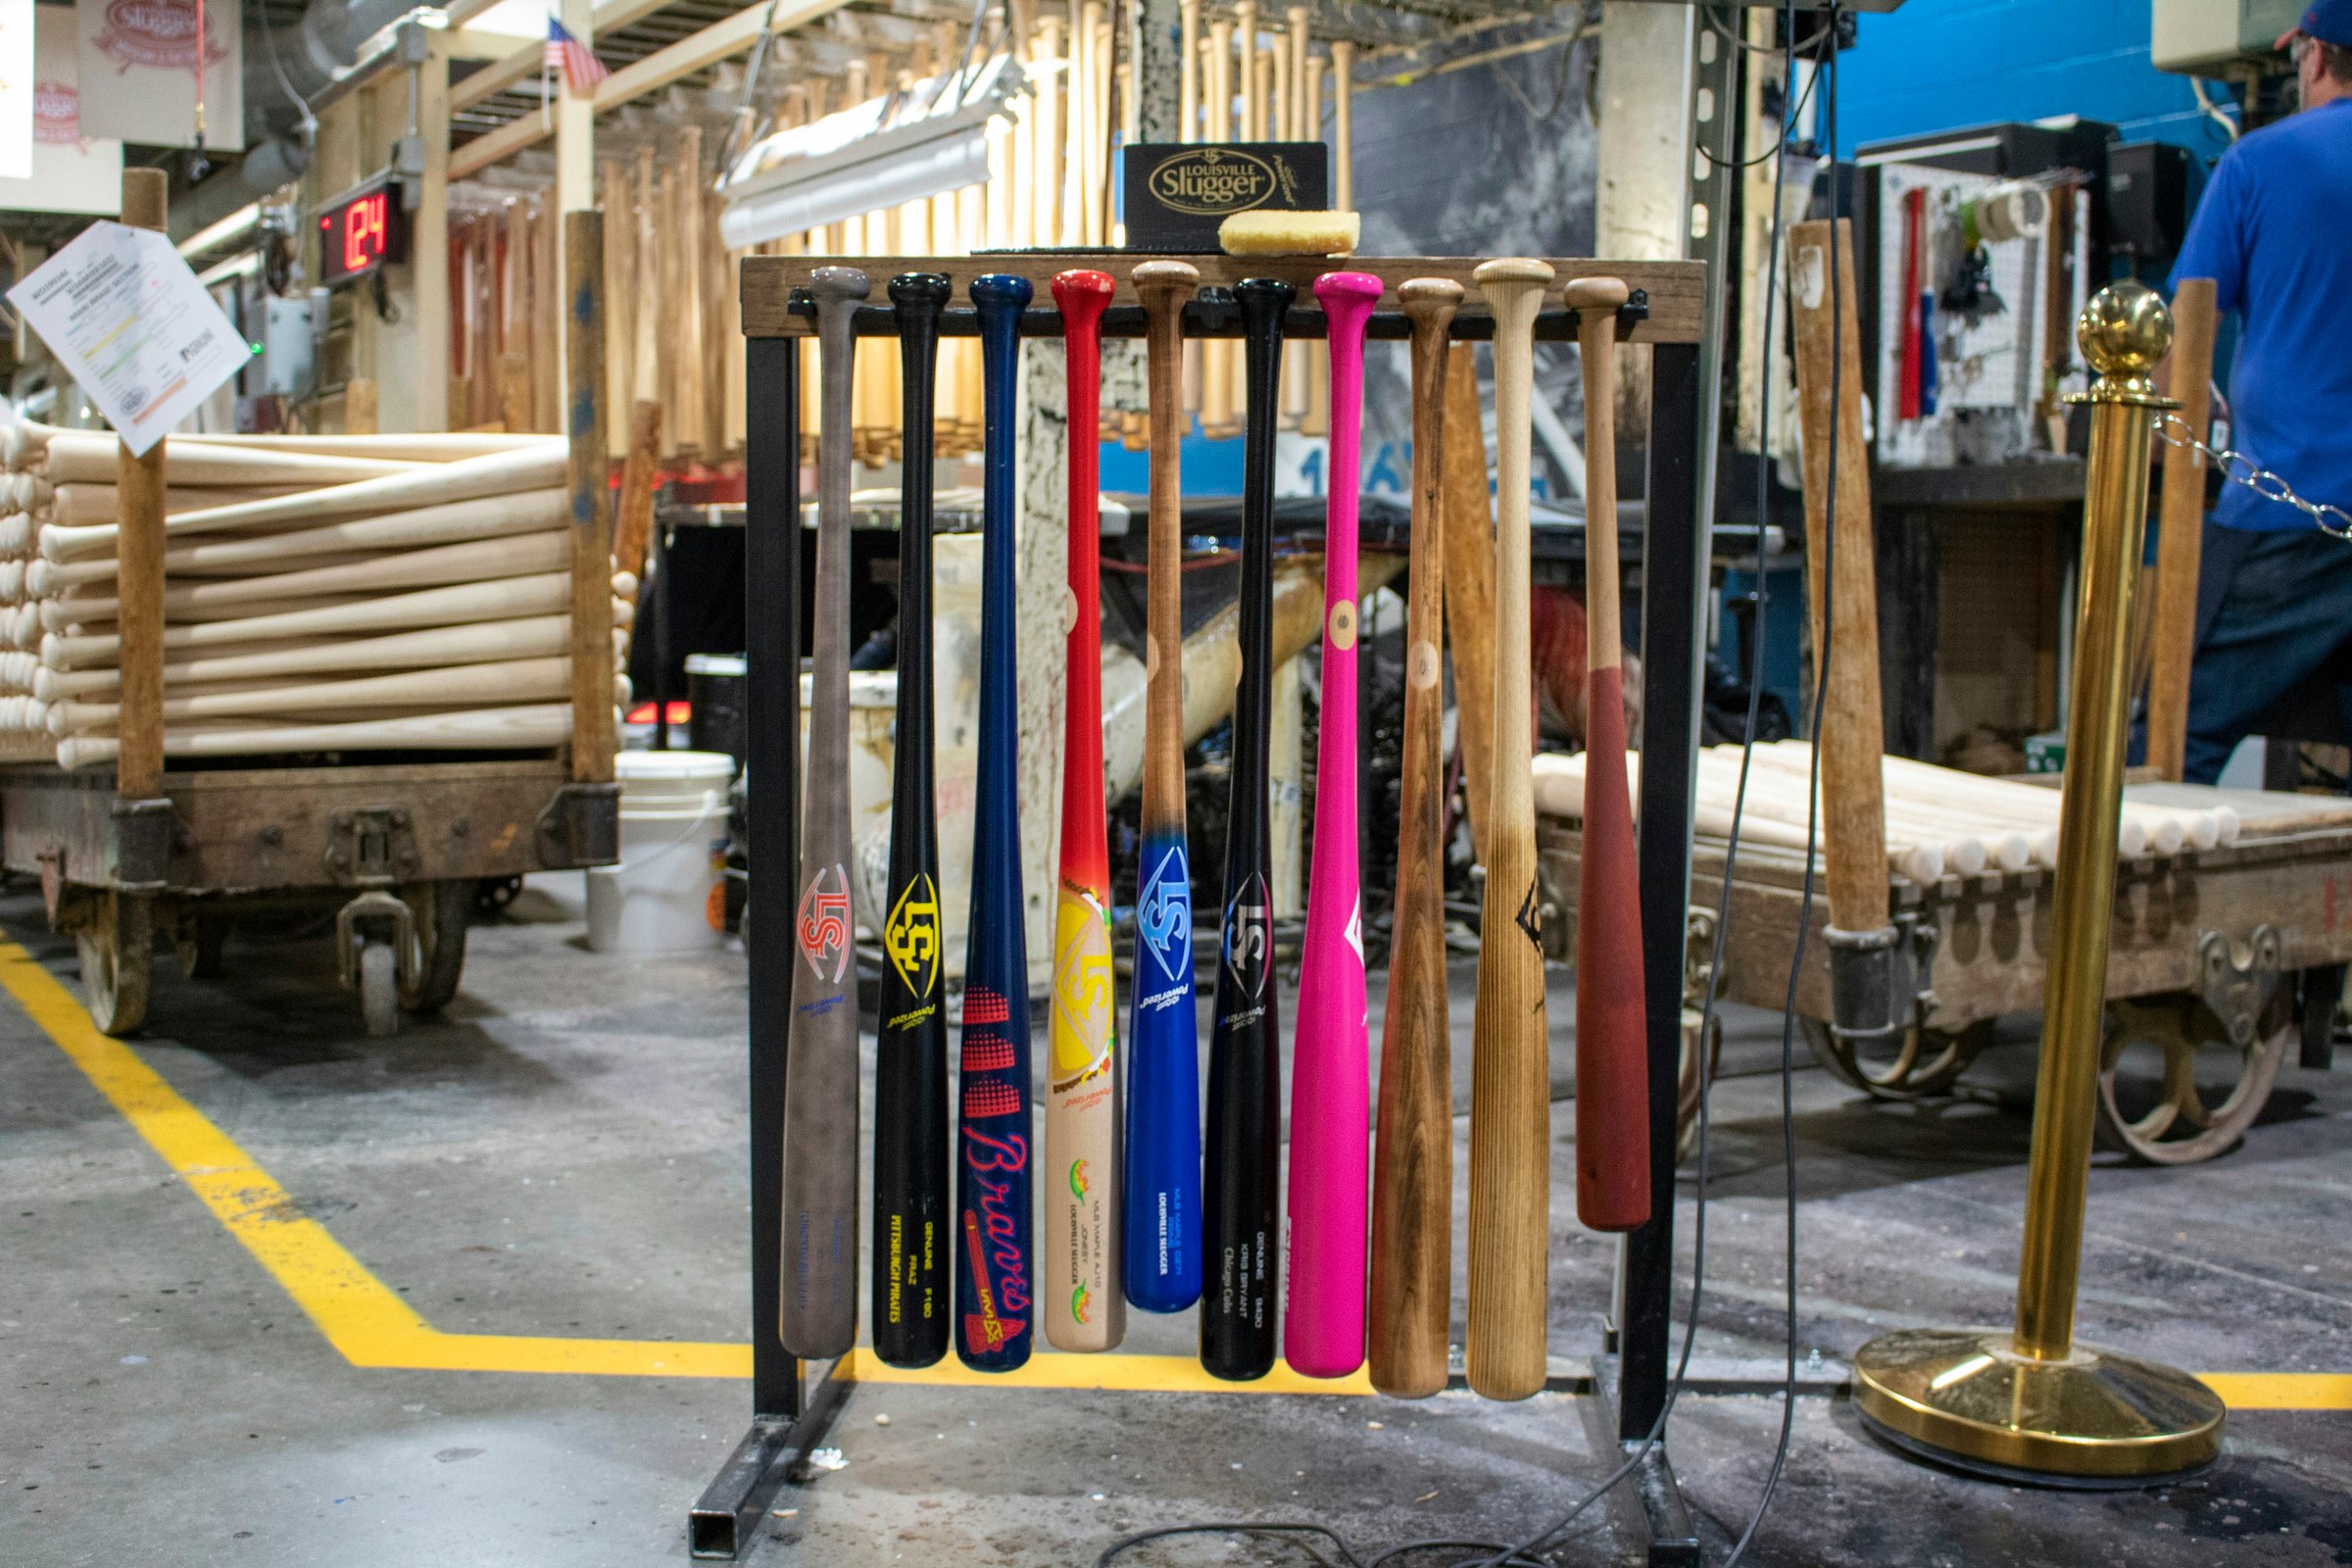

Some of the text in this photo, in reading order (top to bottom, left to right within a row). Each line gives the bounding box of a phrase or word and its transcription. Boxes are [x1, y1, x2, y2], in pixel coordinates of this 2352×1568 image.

[1162, 166, 1260, 203] Slugger
[1187, 165, 1255, 175] LOUISVILLE
[886, 1003, 936, 1029] Powerized
[1139, 982, 1189, 1010] Powerized
[923, 1221, 934, 1270] GENUINE
[961, 1126, 1031, 1312] Braves
[1069, 1203, 1079, 1285] LOUISVILLE SLUGGER
[1158, 1192, 1168, 1276] LOUISVILLE SLUGGER
[889, 1214, 903, 1324] PITTSBURGH PIRATES
[1222, 1248, 1235, 1314] Chicago Cubs
[1239, 1244, 1250, 1319] KRIS BRYANT
[1255, 1231, 1265, 1280] GENUINE
